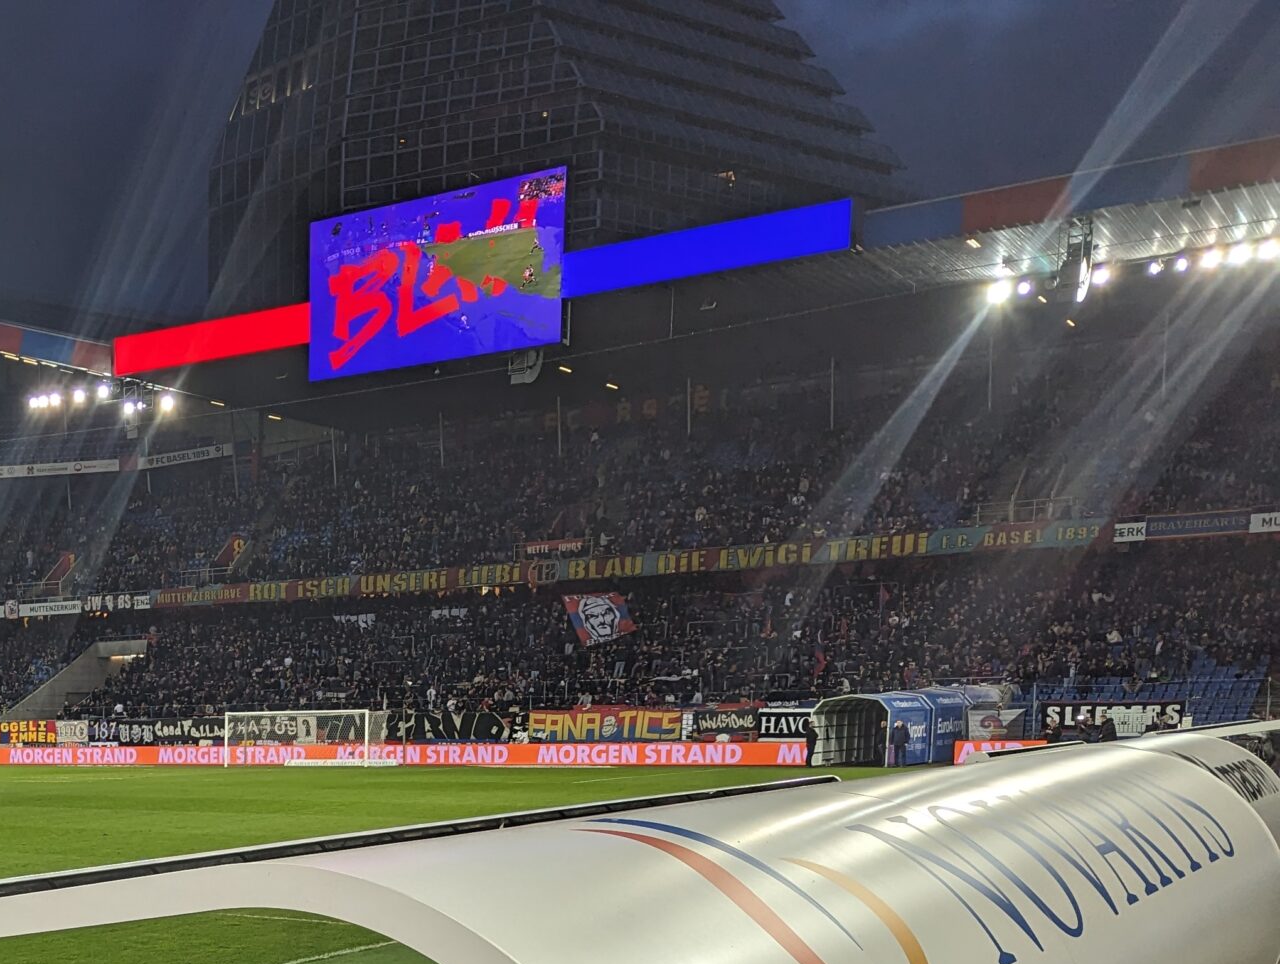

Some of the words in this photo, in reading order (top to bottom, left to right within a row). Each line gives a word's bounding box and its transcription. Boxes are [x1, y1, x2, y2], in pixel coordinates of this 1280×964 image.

[155, 455, 166, 465] FC
[167, 453, 192, 463] BASEL
[983, 529, 1045, 547] BASEL
[1057, 525, 1100, 541] 1893
[9, 731, 56, 744] IMMER
[10, 749, 72, 763] MORGEN
[77, 748, 136, 763] STRAND
[158, 747, 231, 764] MORGEN
[235, 746, 305, 763] STRAND
[336, 745, 420, 764] MORGEN
[427, 743, 507, 763] STRAND
[538, 745, 637, 763] MORGEN
[646, 745, 741, 763] STRAND
